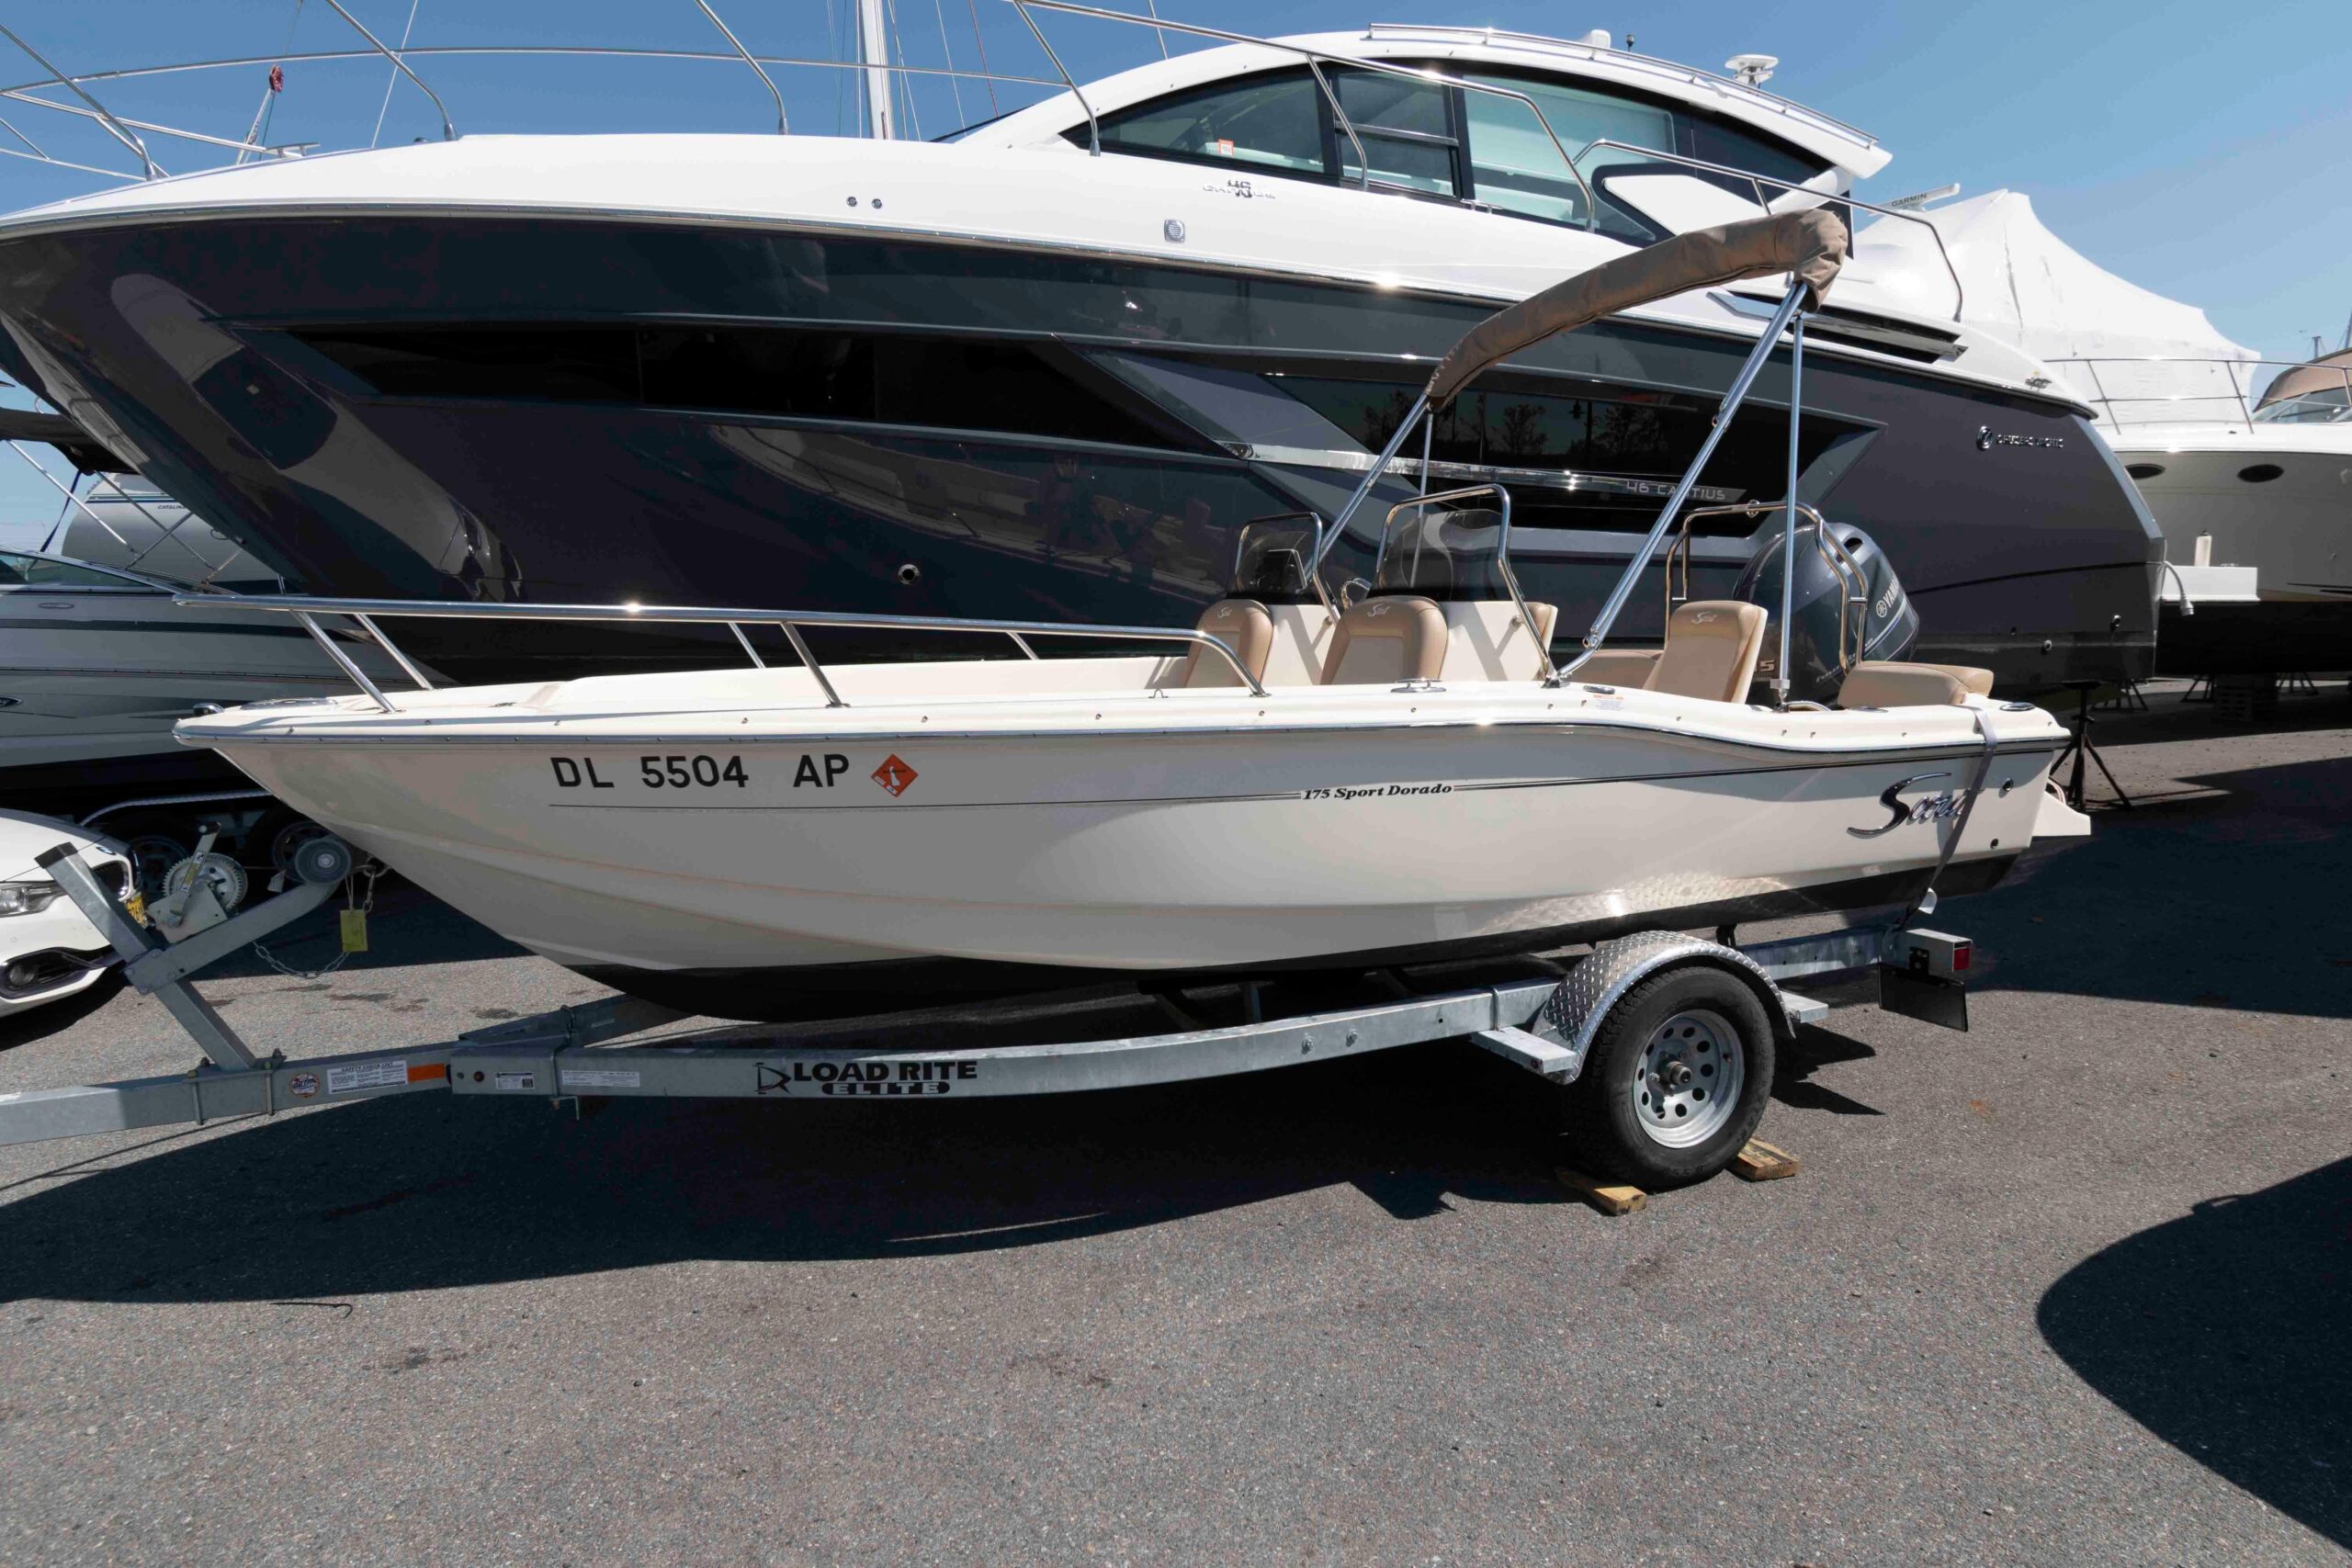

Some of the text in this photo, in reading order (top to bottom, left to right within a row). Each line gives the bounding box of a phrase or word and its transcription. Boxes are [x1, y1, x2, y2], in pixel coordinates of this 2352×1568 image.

[1891, 193, 1927, 207] GARMIN
[1626, 480, 1725, 501] 46 CATIUS
[550, 753, 850, 788] DL 5504 AP
[1303, 784, 1453, 800] 175 Sport Dorado
[794, 1061, 978, 1082] LOAD RITE
[832, 1083, 940, 1095] ELITE
